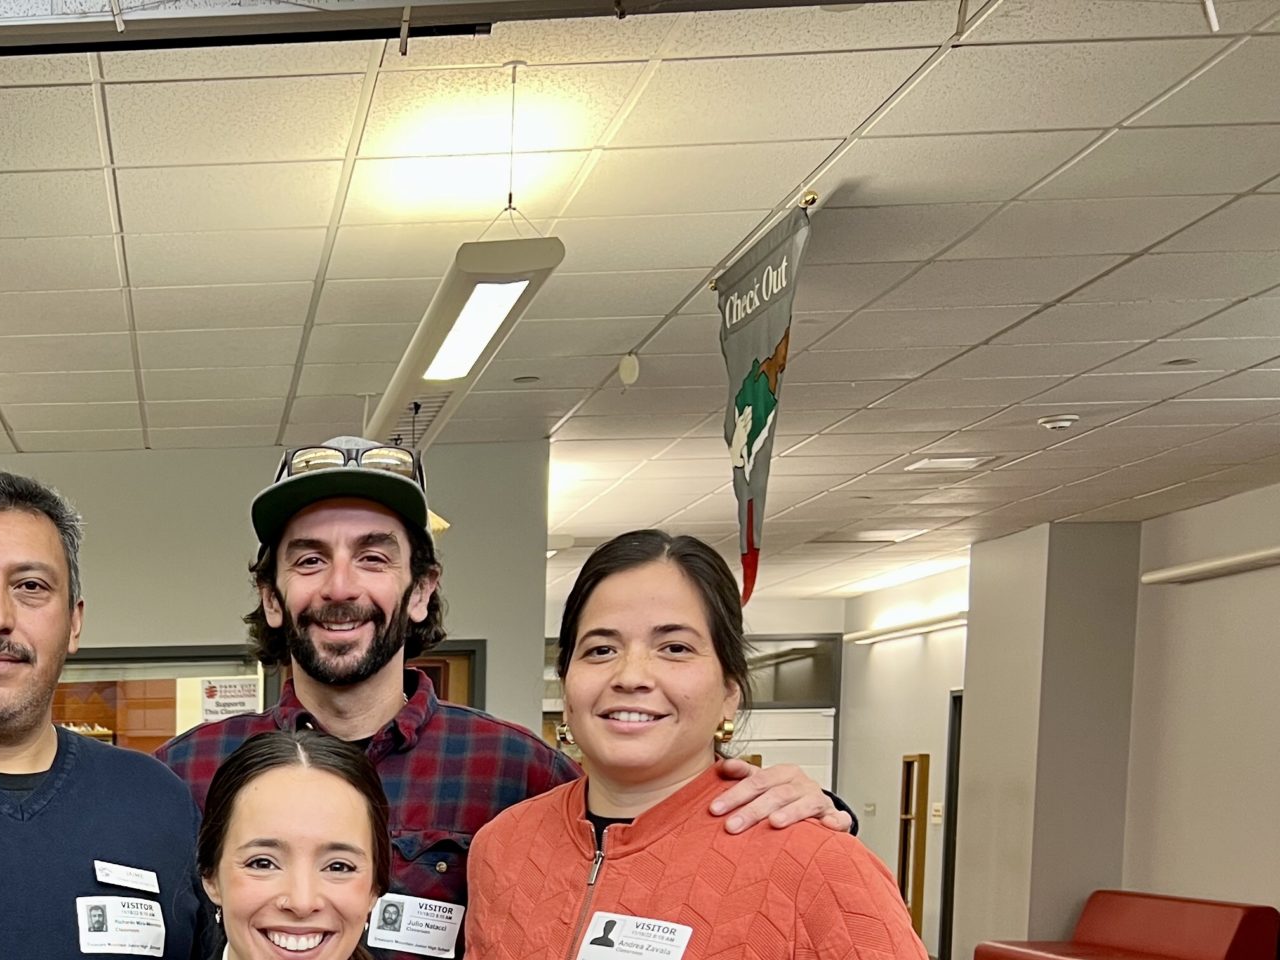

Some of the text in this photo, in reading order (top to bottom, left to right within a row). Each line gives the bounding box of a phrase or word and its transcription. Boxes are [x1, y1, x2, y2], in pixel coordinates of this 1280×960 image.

[725, 255, 788, 328] Check Out
[121, 902, 153, 911] VISITOR
[418, 902, 454, 914] VISITOR
[635, 921, 677, 936] VISITOR
[618, 940, 671, 956] Andrea Zavala
